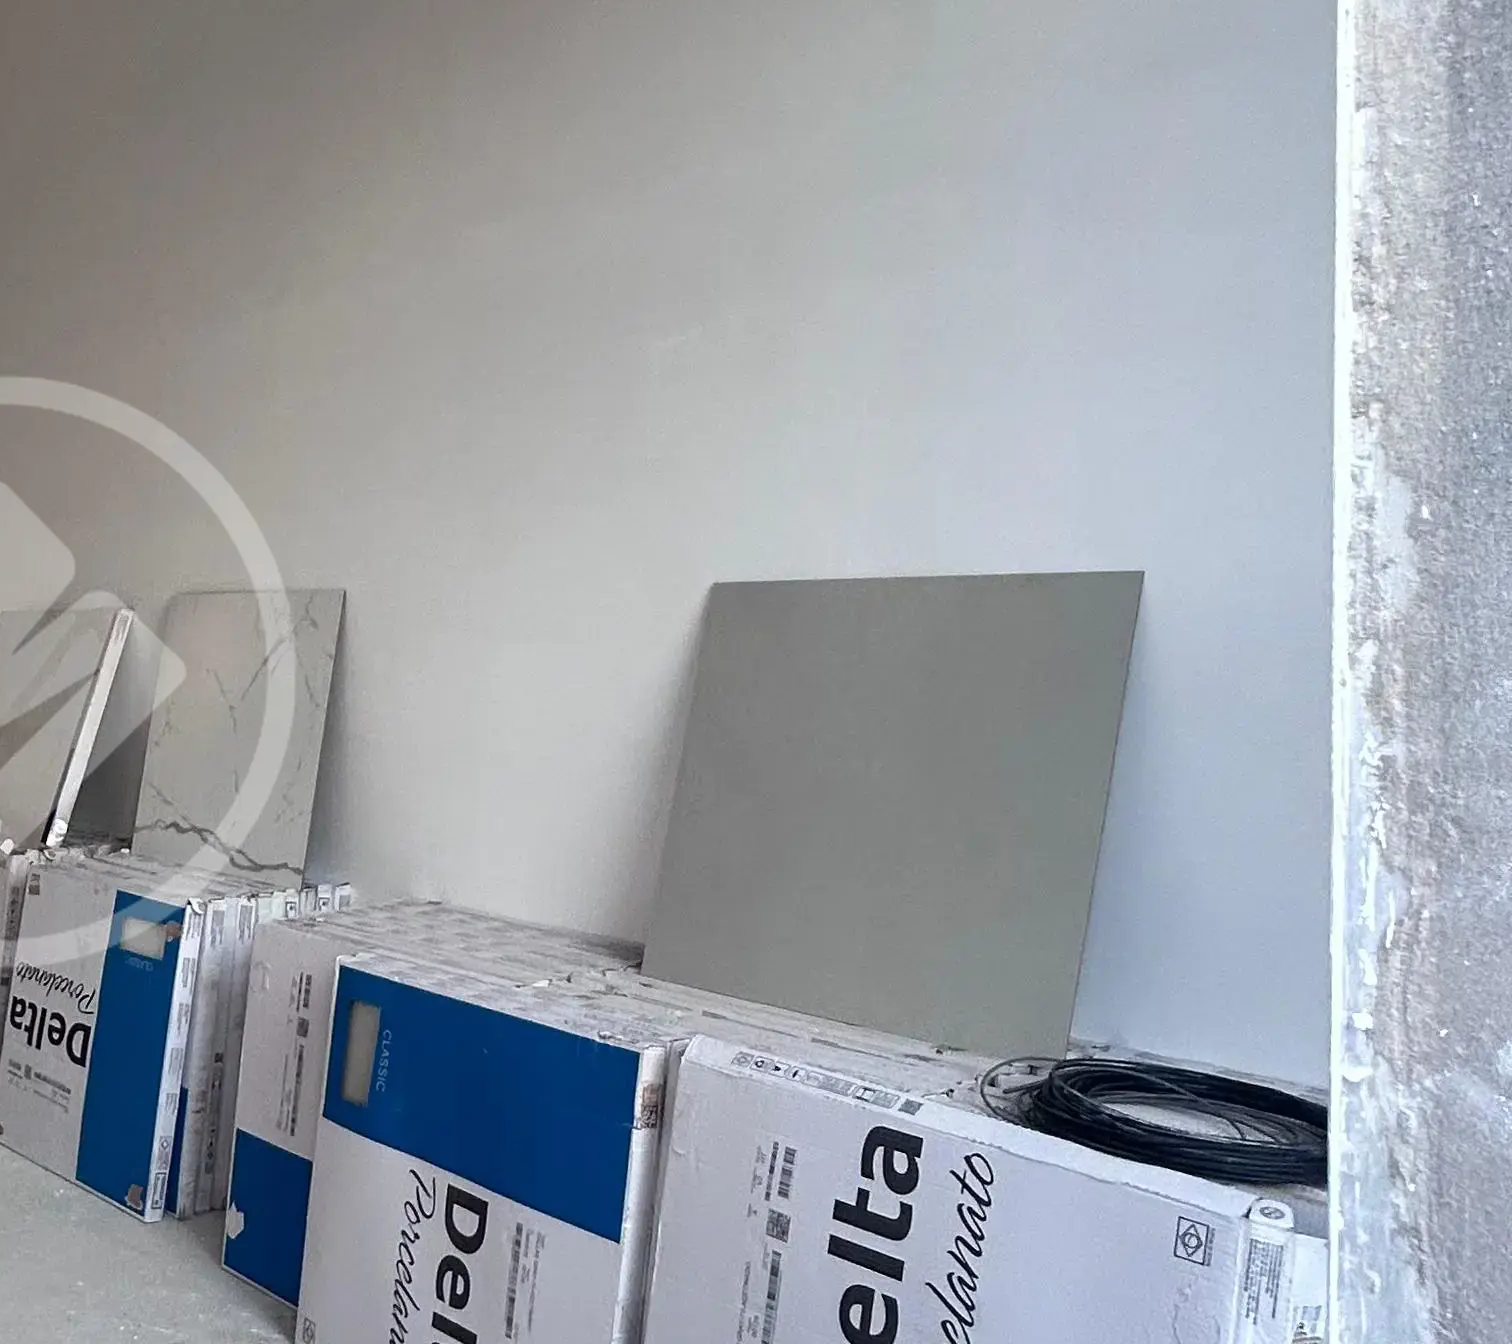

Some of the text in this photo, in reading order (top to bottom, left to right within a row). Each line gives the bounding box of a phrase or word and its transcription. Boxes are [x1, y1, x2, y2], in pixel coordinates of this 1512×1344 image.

[15, 960, 97, 1015] Porcelanato
[9, 995, 92, 1068] Delta
[376, 1029, 392, 1092] CLASSIC
